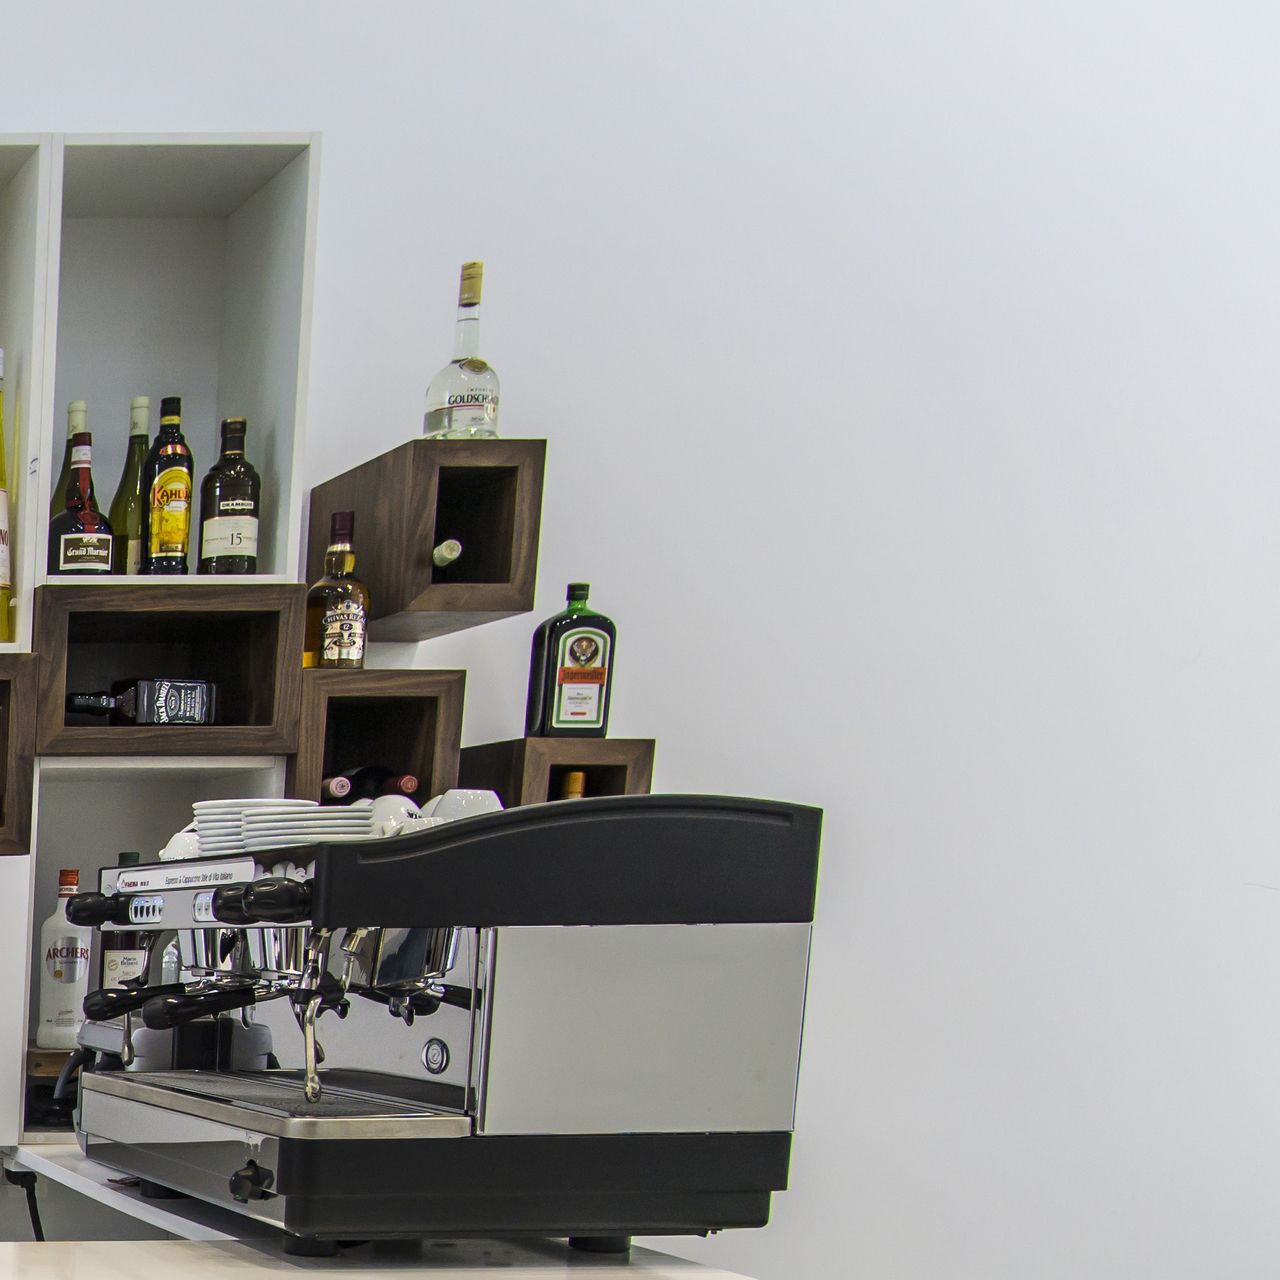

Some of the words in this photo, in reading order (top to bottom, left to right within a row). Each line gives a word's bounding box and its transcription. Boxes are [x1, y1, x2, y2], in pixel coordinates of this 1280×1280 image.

[152, 485, 191, 507] KAHLÚ
[230, 532, 242, 546] 15
[322, 613, 348, 625] CHIVAS
[46, 946, 89, 961] ARCHERS
